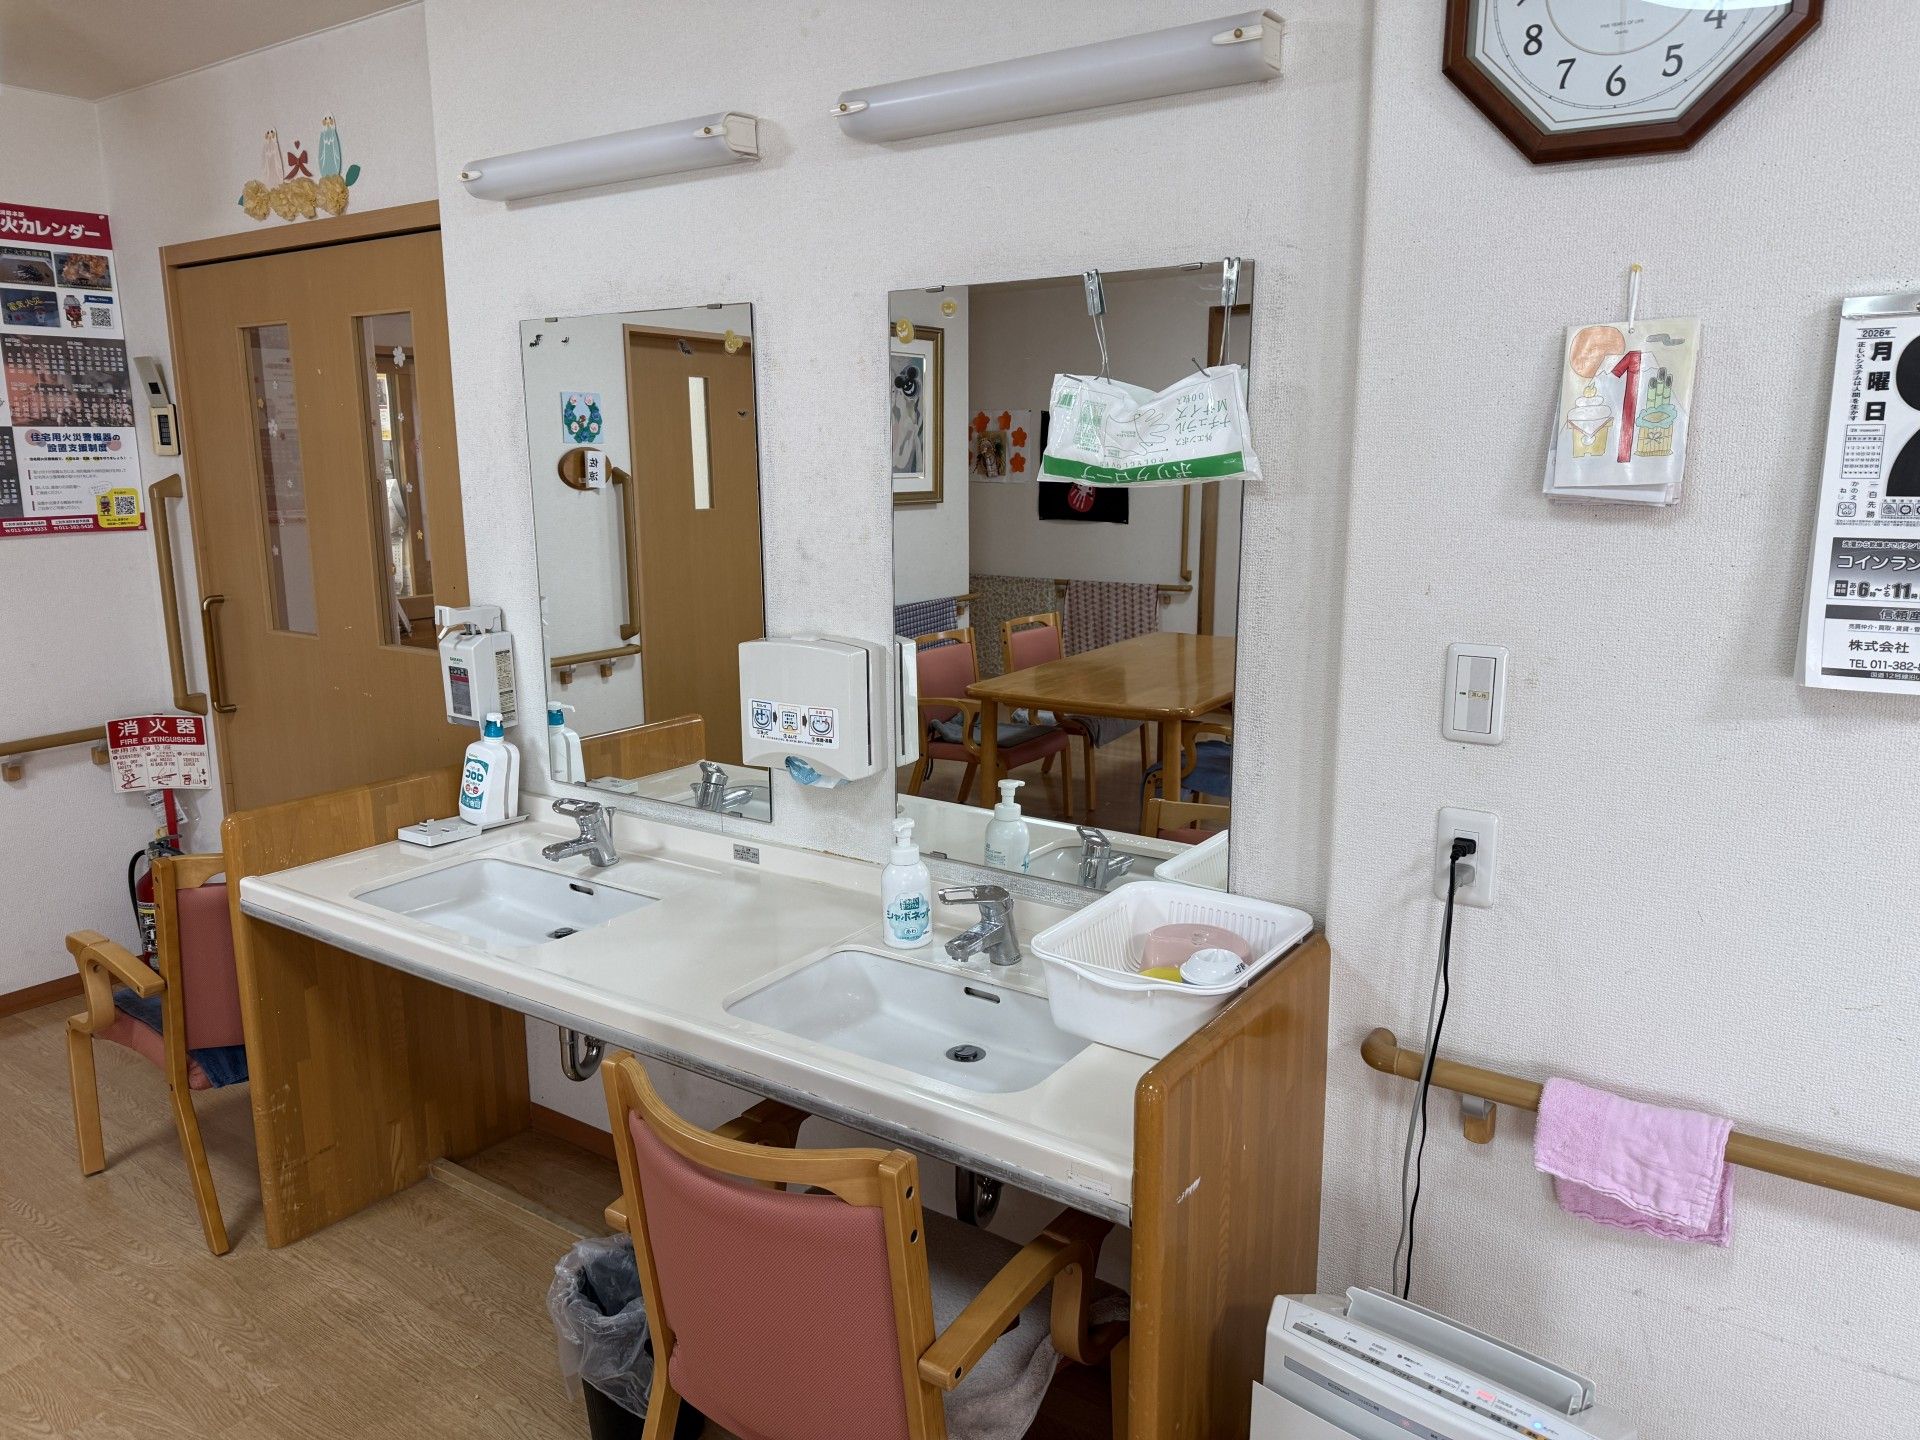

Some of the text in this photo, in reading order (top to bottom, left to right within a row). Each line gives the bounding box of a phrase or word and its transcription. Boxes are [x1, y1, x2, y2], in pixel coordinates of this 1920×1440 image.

[1523, 24, 1543, 56] 8
[1662, 43, 1684, 77] 5
[1557, 58, 1576, 90] 7
[1605, 64, 1626, 97] 6
[0, 216, 101, 240] 火カレンダー
[1862, 329, 1891, 338] 2026年
[1865, 341, 1893, 421] 月曜日
[1610, 350, 1642, 463] 1
[1175, 415, 1231, 434] ナチュラル
[31, 432, 121, 443] 住宅用火災警報器の
[1176, 433, 1212, 446] 外エンボス
[48, 443, 108, 453] 設置支援制度
[1850, 481, 1859, 501] かのえ
[1837, 555, 1920, 571] コインラン
[1848, 639, 1910, 654] 株式会社
[1849, 659, 1920, 671] TEL 011-382-
[117, 718, 196, 737] 消火器
[142, 736, 197, 744] EXTINGUISHER
[465, 769, 484, 782] コロロ
[887, 908, 931, 921] シャボネット
